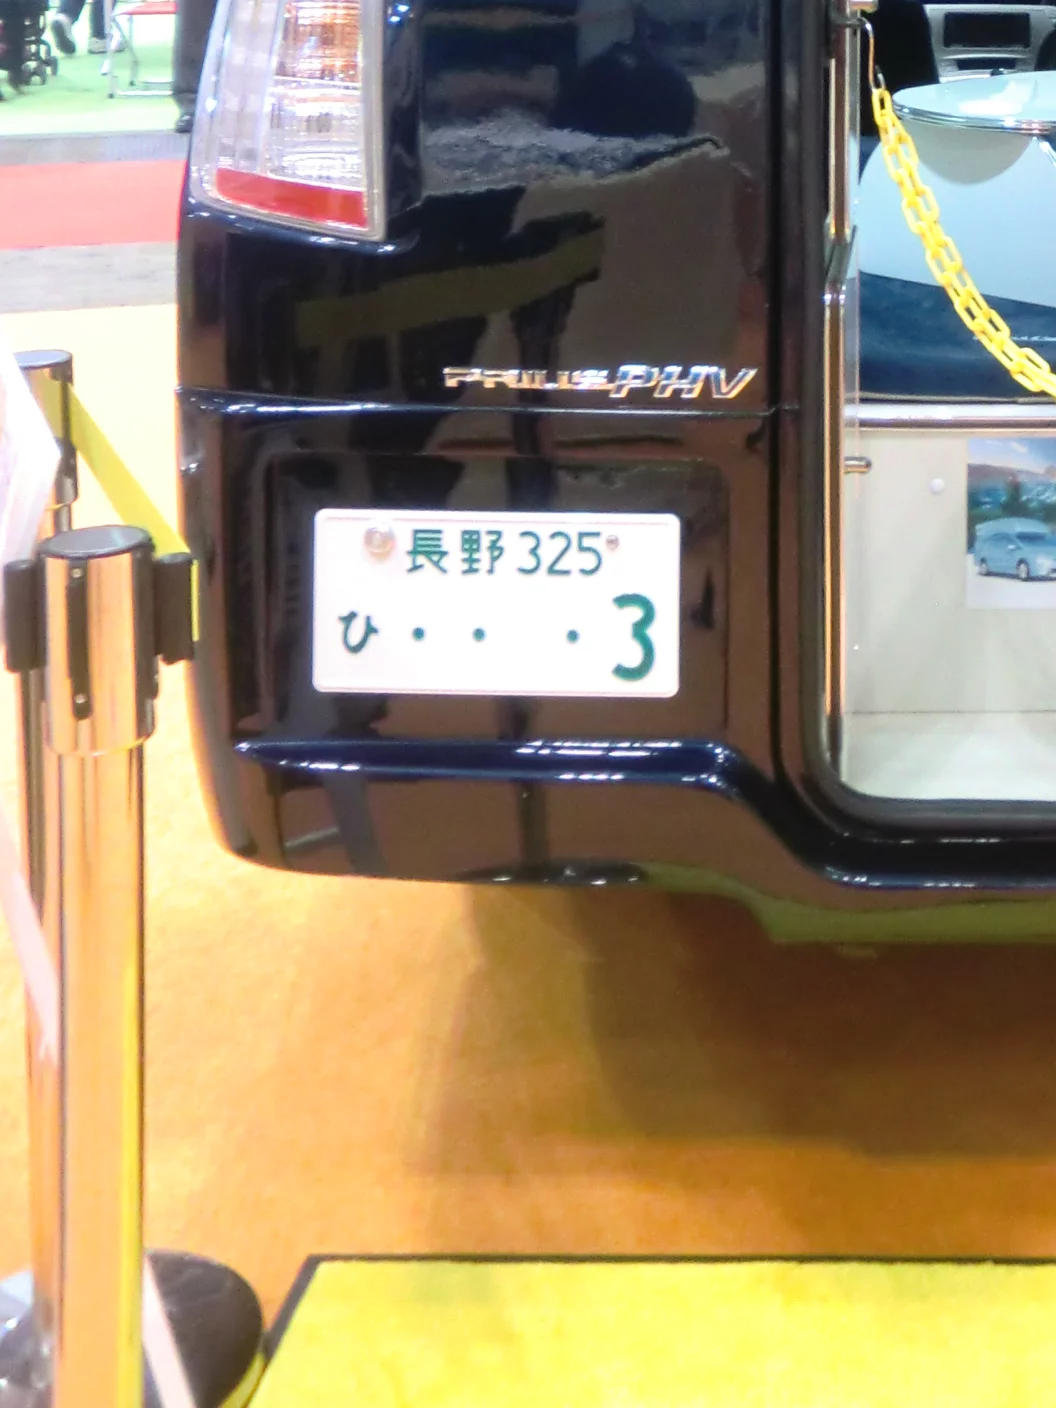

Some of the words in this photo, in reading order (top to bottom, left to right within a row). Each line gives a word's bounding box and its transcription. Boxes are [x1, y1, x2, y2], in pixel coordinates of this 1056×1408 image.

[609, 364, 759, 398] PHV
[406, 529, 504, 575] 長野
[517, 530, 602, 577] 325
